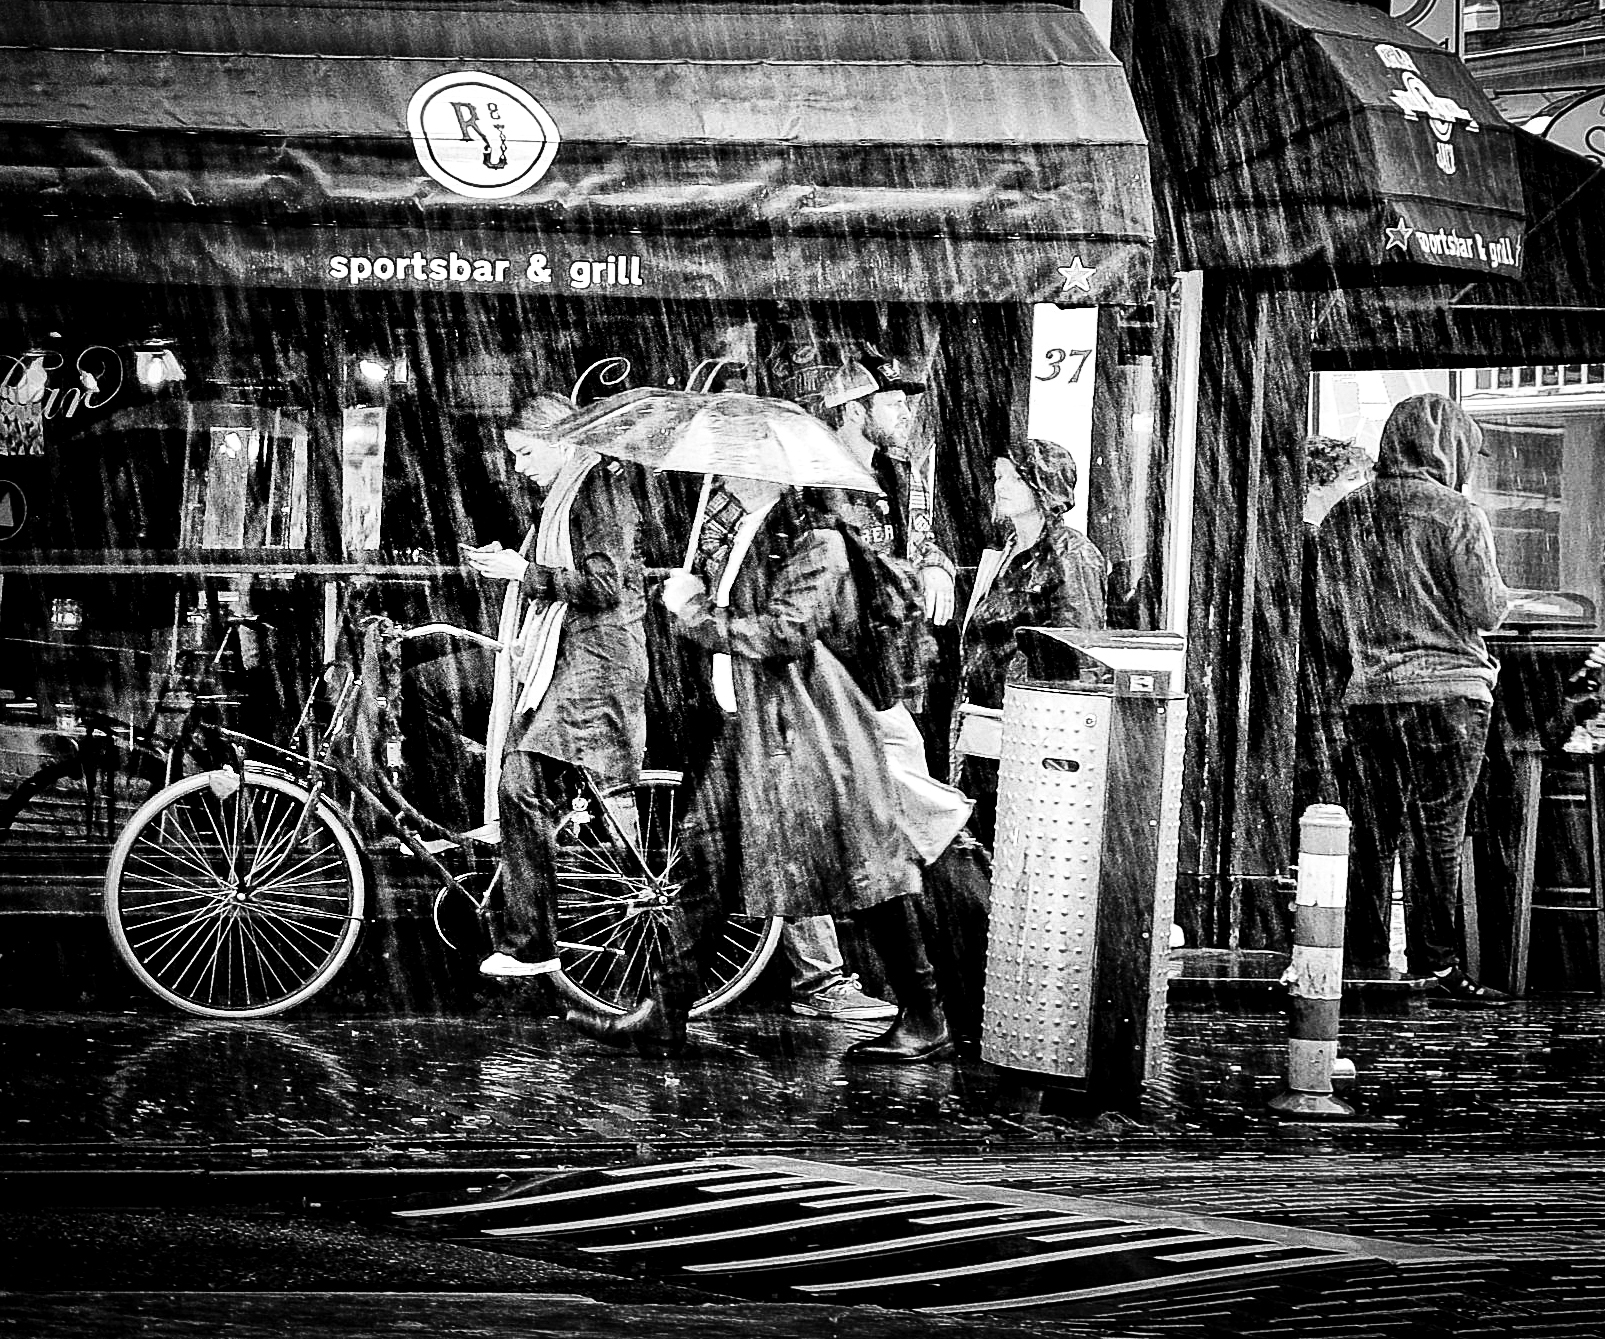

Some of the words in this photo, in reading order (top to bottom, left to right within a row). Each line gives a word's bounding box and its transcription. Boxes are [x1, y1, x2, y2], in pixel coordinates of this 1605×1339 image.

[1489, 237, 1515, 268] grill
[329, 252, 510, 284] sportsbar
[526, 253, 552, 283] &
[570, 254, 643, 289] grill
[1035, 348, 1092, 383] 37
